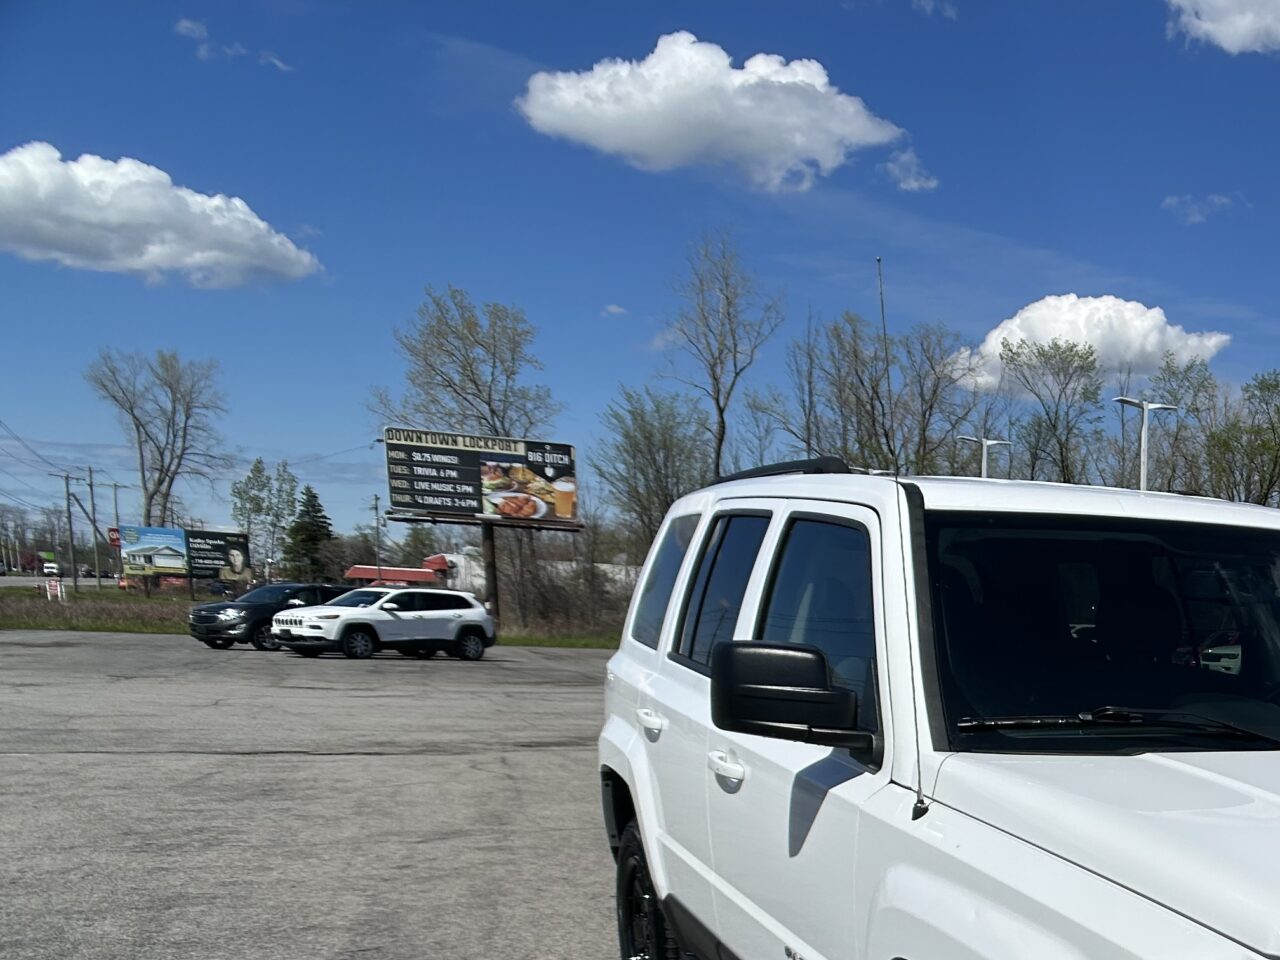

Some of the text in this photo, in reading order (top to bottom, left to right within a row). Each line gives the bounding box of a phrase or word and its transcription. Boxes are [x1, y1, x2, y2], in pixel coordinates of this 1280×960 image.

[387, 429, 518, 452] DOWNTOWN LOCKPORT
[528, 451, 569, 465] BIG DITCH
[414, 481, 430, 490] LIVE
[424, 496, 453, 506] DRAFTS
